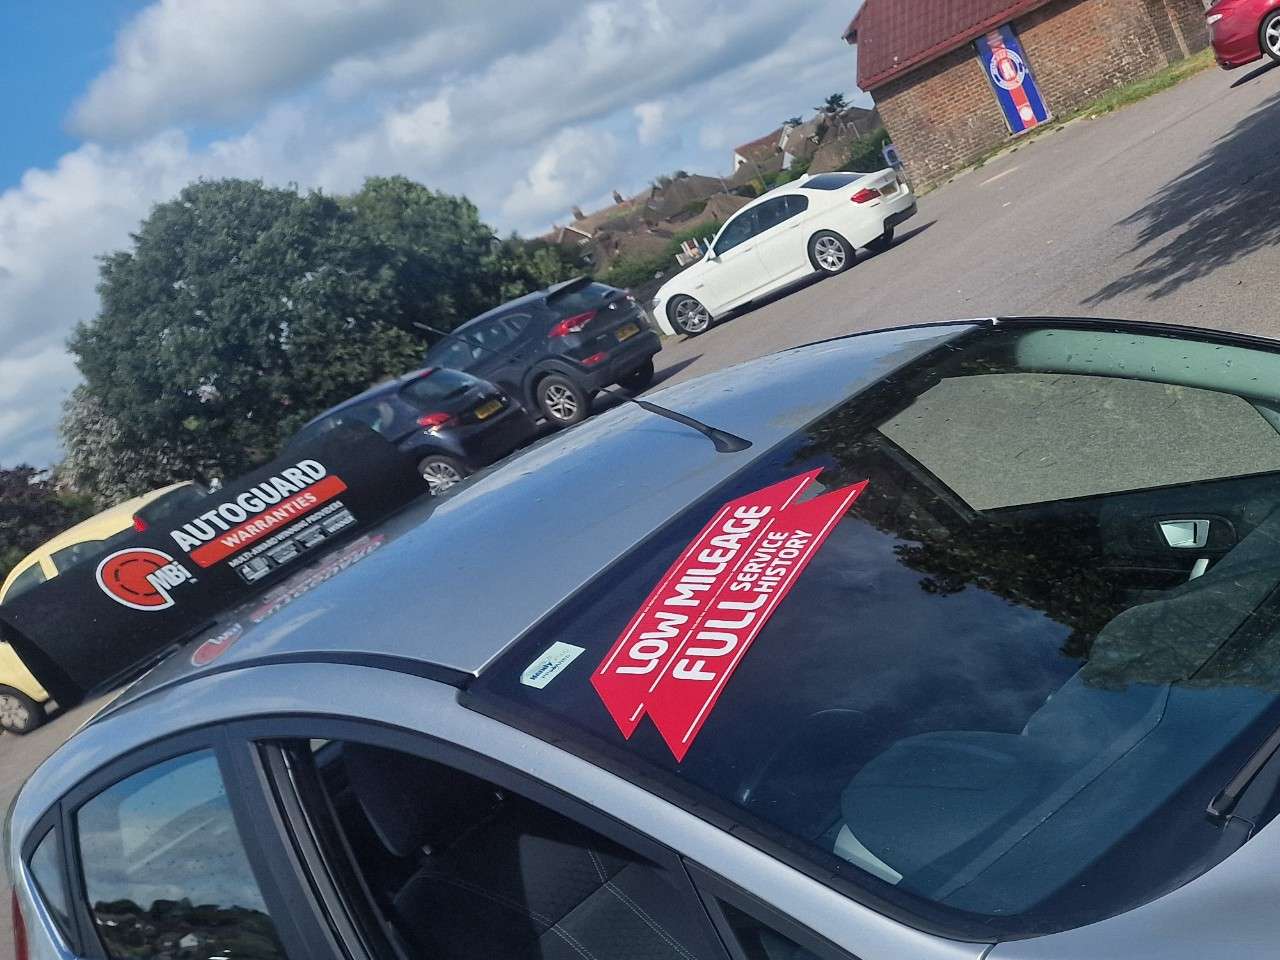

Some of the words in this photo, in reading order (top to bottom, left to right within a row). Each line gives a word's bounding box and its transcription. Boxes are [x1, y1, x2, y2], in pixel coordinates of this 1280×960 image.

[170, 459, 327, 552] AUTOGUARD
[221, 492, 317, 547] WARRANTIES
[615, 611, 689, 675] LOW
[663, 505, 772, 607] MILEAGE
[730, 531, 790, 592] SERVICE
[752, 529, 813, 593] HISTORY
[672, 593, 769, 681] FULL
